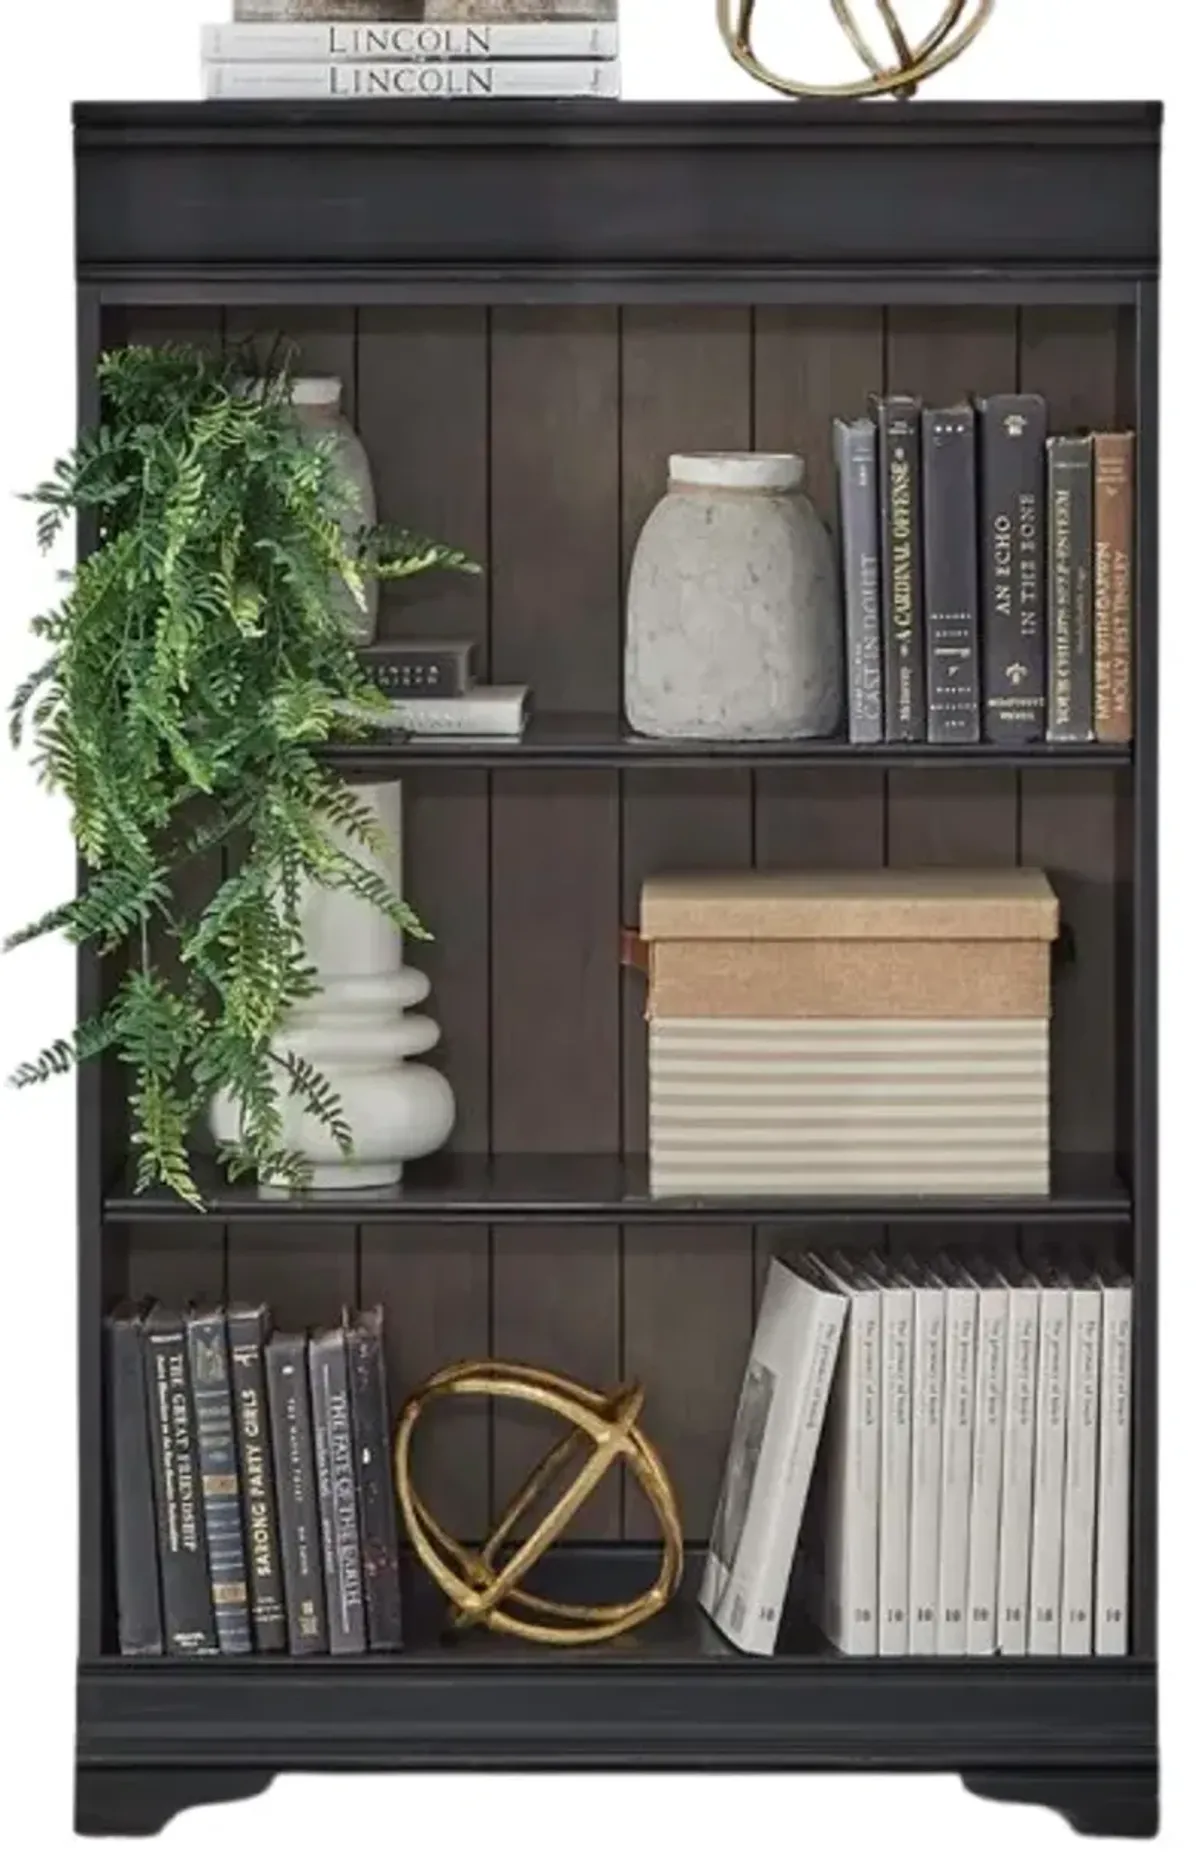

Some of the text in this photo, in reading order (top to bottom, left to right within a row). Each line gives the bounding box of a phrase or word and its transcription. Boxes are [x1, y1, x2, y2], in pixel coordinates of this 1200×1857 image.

[329, 26, 491, 54] LINCOLN
[329, 67, 493, 94] LINCOLN
[891, 461, 913, 643] A CARDINAL OFFENSE
[994, 515, 1011, 616] AN ECHO
[1019, 493, 1036, 636] IN THE BONE
[862, 635, 880, 660] IN
[862, 667, 881, 720] CAST
[241, 1389, 259, 1438] GIRLS
[331, 1391, 346, 1426] THE
[170, 1354, 196, 1552] THE GREAT FRIENDSHIP
[245, 1443, 265, 1498] PARTY
[333, 1433, 349, 1478] FATE
[250, 1502, 271, 1577] SARONG
